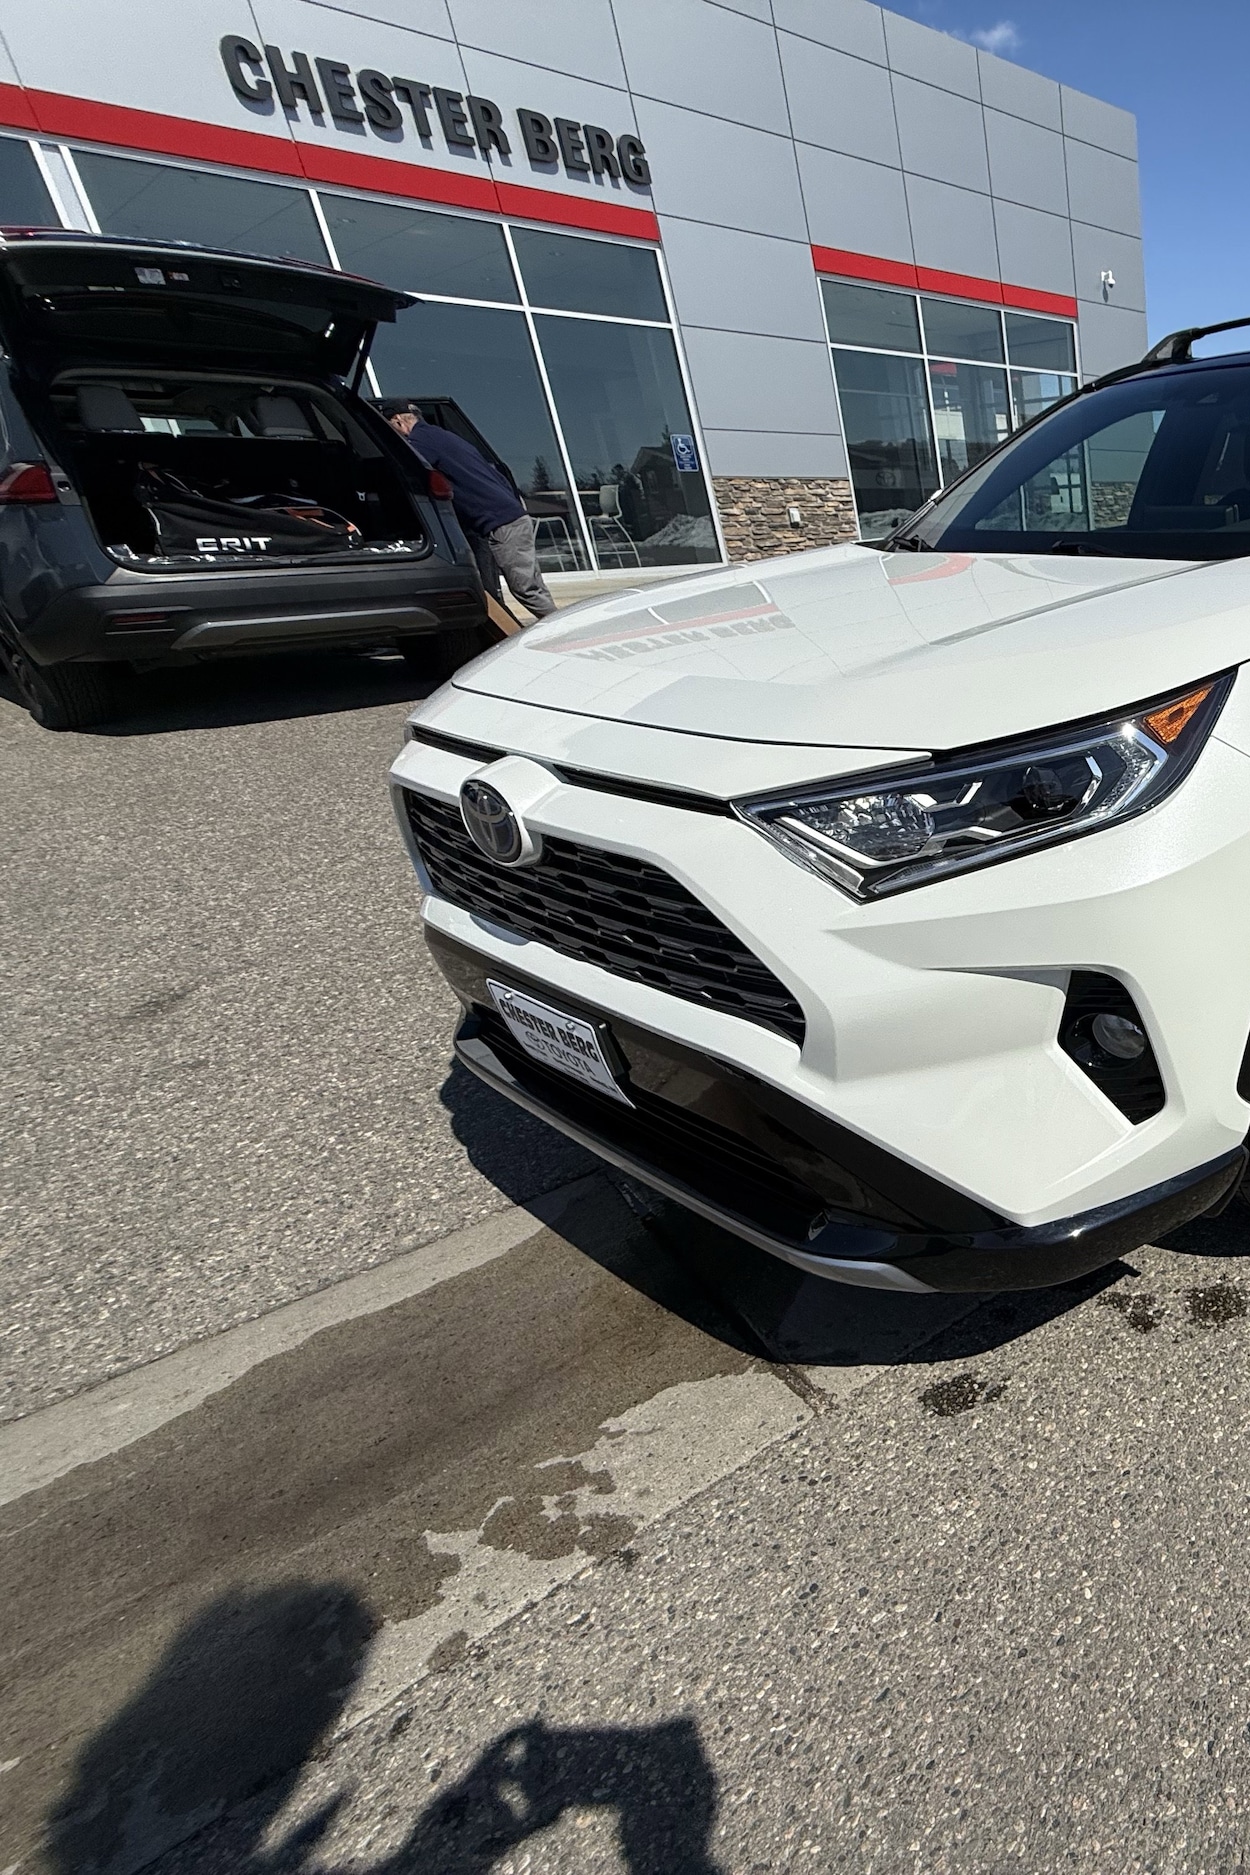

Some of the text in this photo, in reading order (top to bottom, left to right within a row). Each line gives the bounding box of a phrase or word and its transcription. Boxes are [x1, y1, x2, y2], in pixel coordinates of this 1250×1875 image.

[219, 34, 653, 185] CHESTER BERG
[196, 537, 272, 552] GRIT
[499, 998, 600, 1062] CHESTER BERG
[541, 1038, 596, 1077] TOYOTA
